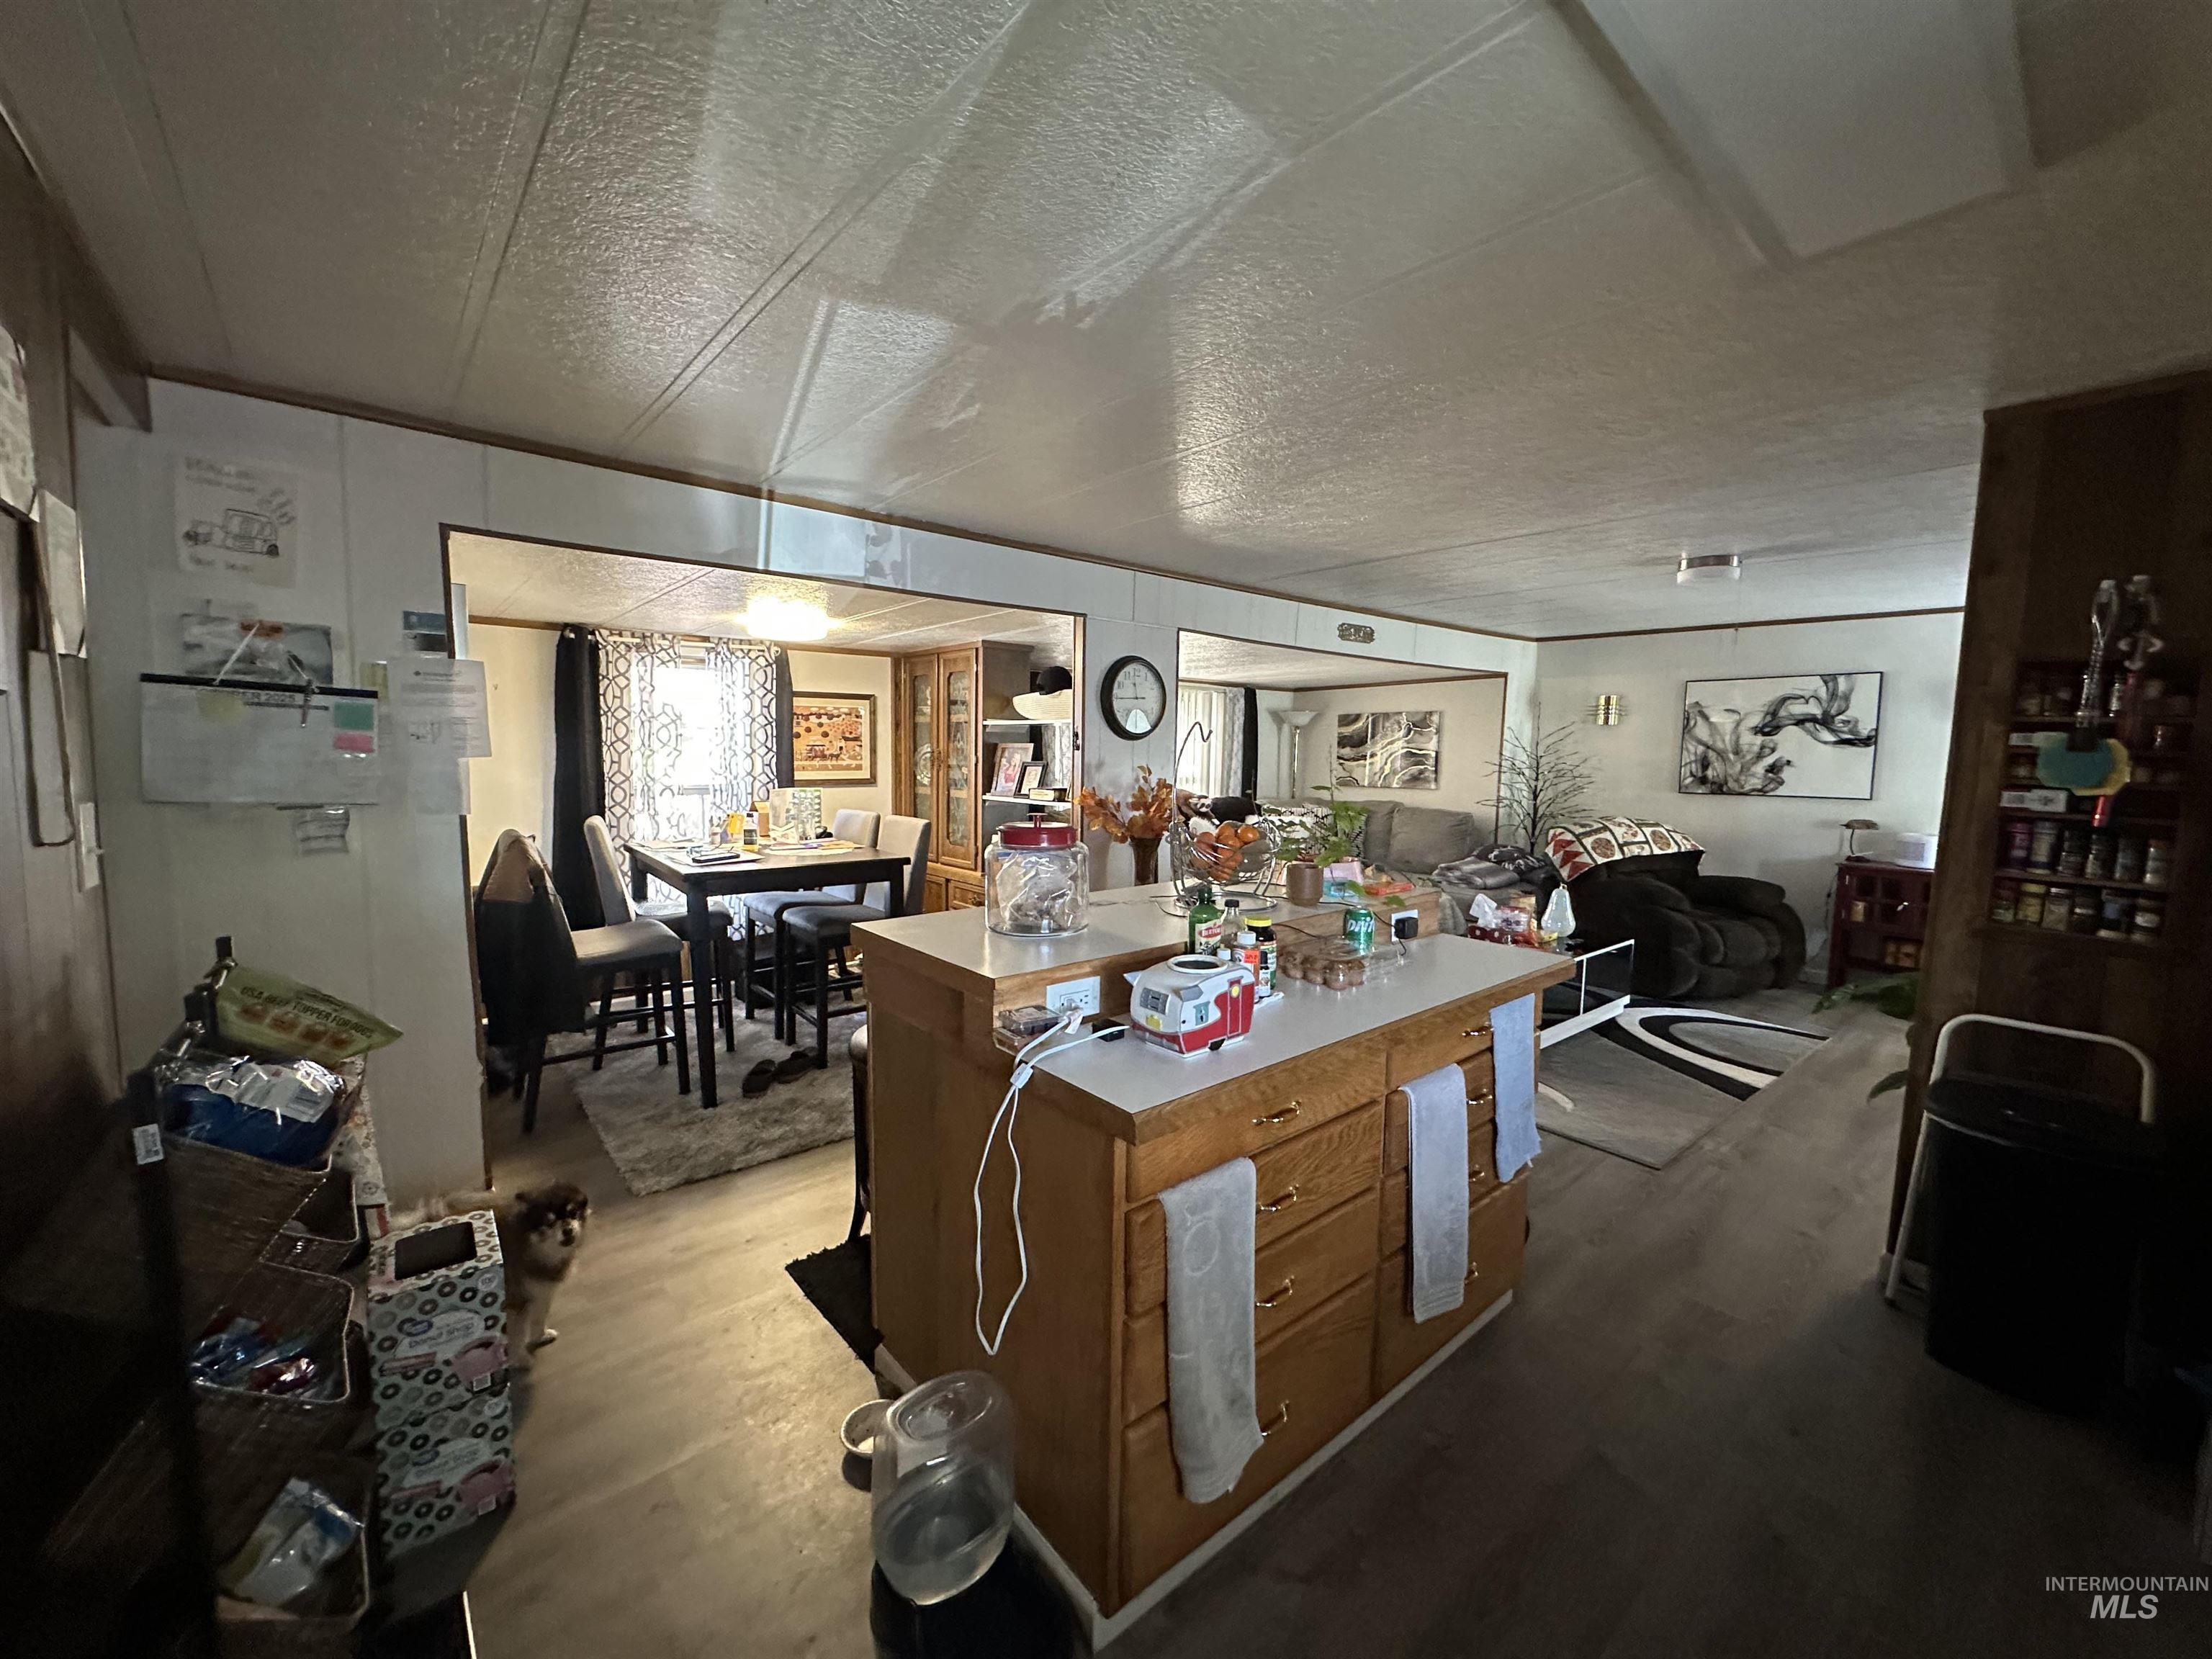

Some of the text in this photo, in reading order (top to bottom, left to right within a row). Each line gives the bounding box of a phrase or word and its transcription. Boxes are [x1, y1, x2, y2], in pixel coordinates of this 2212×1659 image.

[1133, 667, 1141, 678] 12
[240, 986, 264, 1000] USA
[292, 1001, 333, 1021] TOPPER
[331, 1014, 352, 1028] FOR
